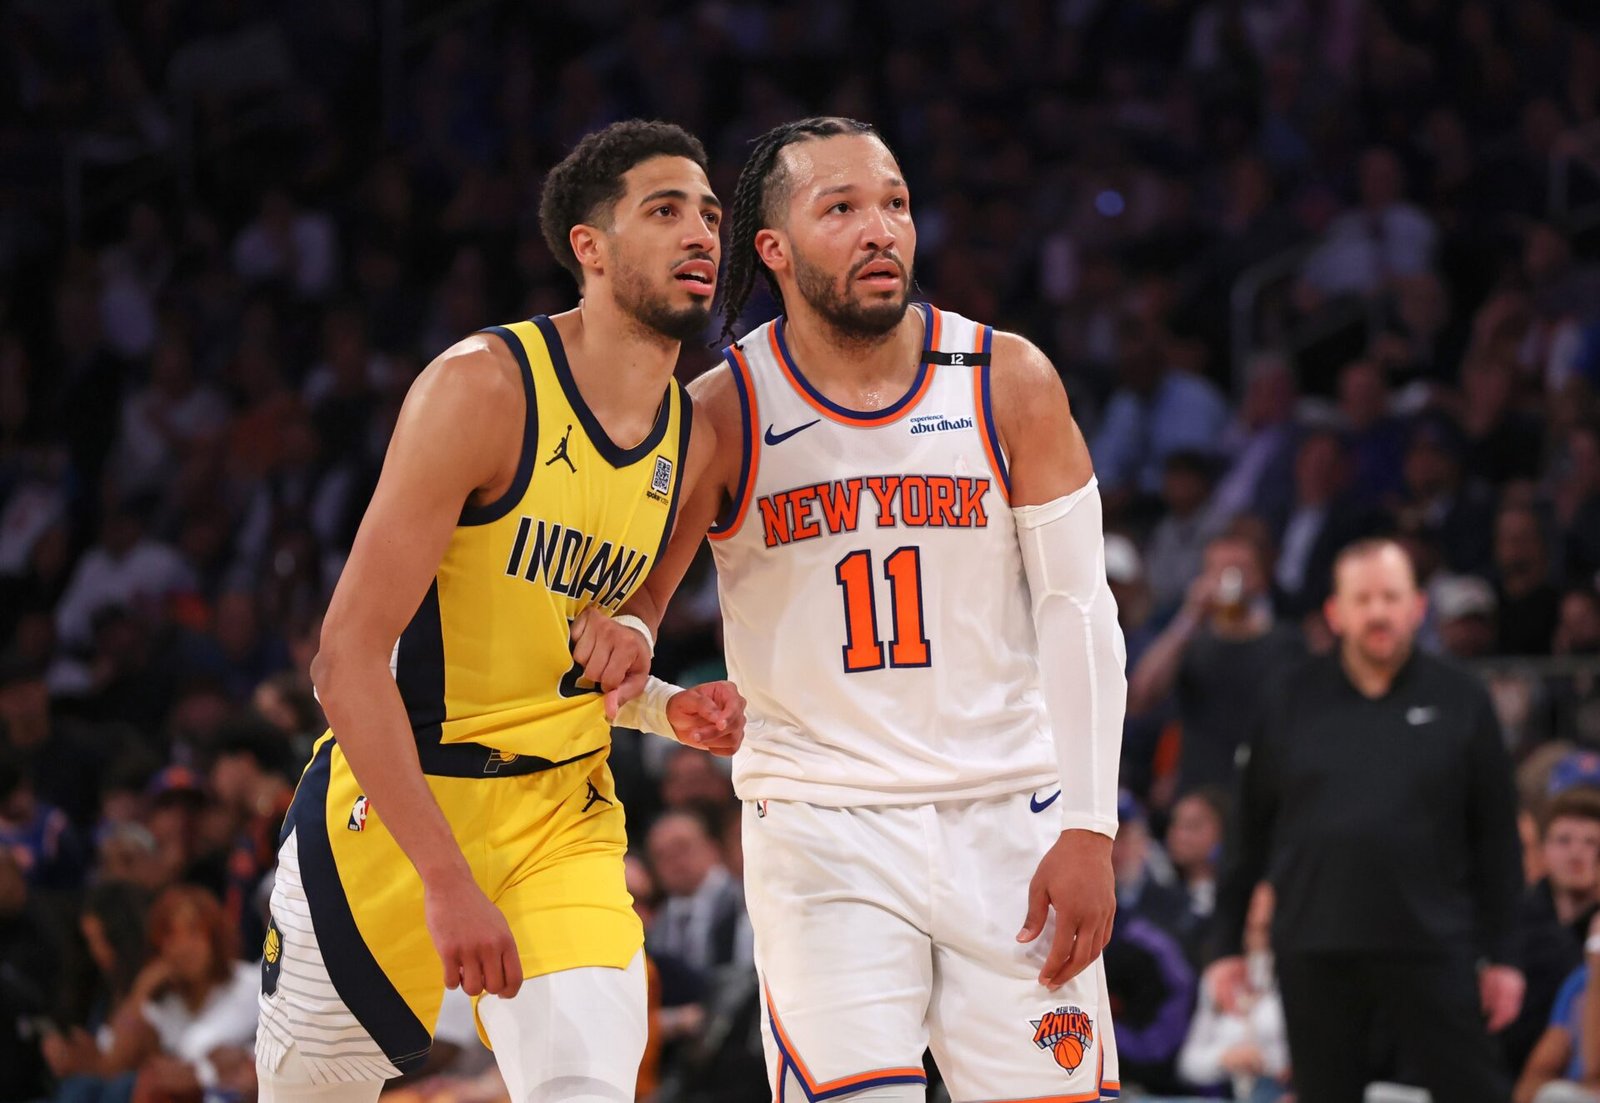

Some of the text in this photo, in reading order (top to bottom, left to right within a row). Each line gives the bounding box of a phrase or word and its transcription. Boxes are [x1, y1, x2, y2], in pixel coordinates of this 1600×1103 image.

[951, 354, 963, 364] 12
[910, 417, 972, 434] abu dhabi
[757, 474, 992, 549] NEW YORK
[505, 516, 649, 611] INDIANA
[835, 545, 931, 673] 11
[1033, 1012, 1093, 1042] KNICKS
